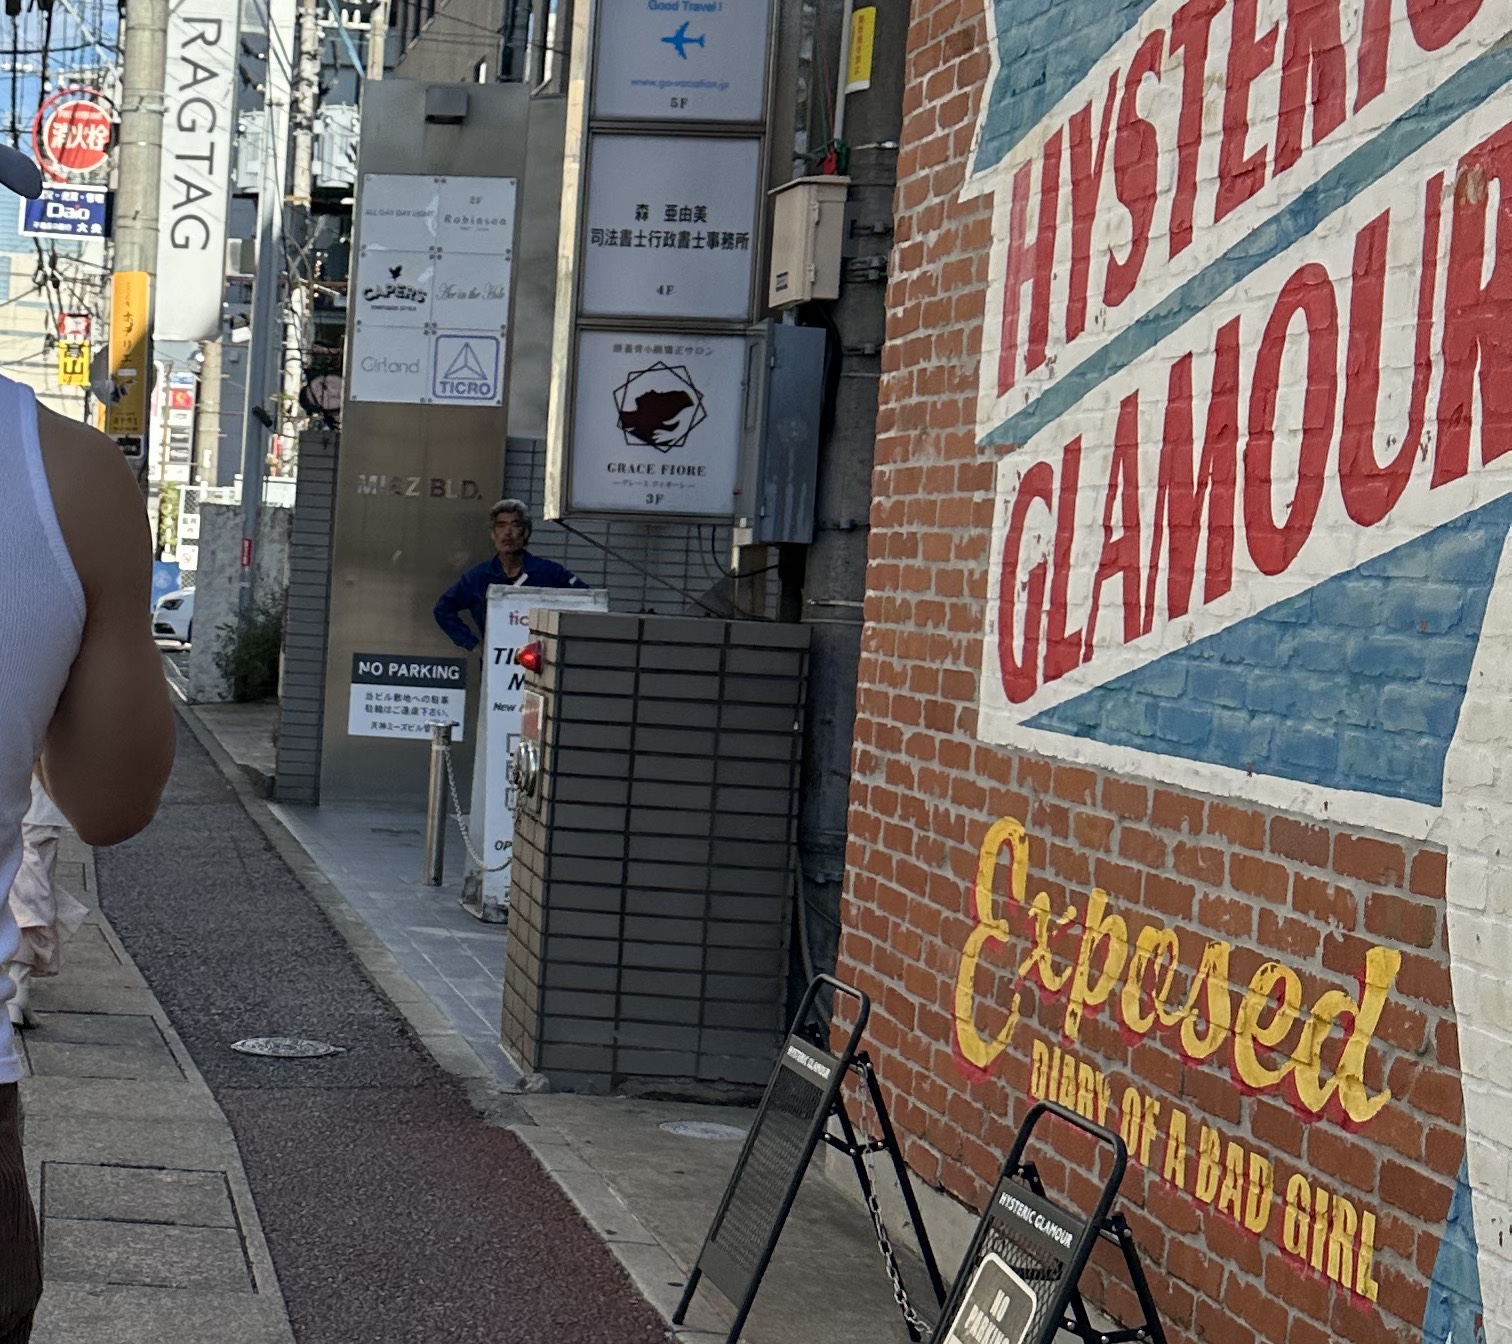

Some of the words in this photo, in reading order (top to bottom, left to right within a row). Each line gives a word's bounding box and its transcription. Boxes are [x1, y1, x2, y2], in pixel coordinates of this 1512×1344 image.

[648, 0, 679, 11] Good
[670, 97, 689, 110] 5F
[51, 121, 110, 151] 消火栓
[170, 16, 222, 251] RAGTAG
[635, 203, 649, 221] 森
[663, 204, 708, 224] 亜由美
[590, 227, 750, 251] 司法書士行政書士事務所
[362, 283, 428, 304] CAPERS
[656, 285, 675, 296] 4F
[439, 380, 491, 395] TICRO
[996, 120, 1512, 706] GLAMOUR
[607, 462, 656, 476] GRACE
[660, 464, 707, 477] FIORE
[430, 478, 483, 500] BLD.
[645, 493, 665, 506] 3F
[358, 660, 384, 676] NO
[388, 662, 461, 680] PARKING
[953, 814, 1403, 1124] Exposed
[1031, 1038, 1111, 1129] DIARY
[1119, 1086, 1161, 1167] OF
[1163, 1107, 1187, 1190] A
[1194, 1124, 1274, 1235] BAD
[1284, 1173, 1379, 1302] GIRL
[998, 1191, 1036, 1224] HYSTERIC
[1034, 1213, 1074, 1249] GLAMOUR
[989, 1288, 1011, 1322] NO
